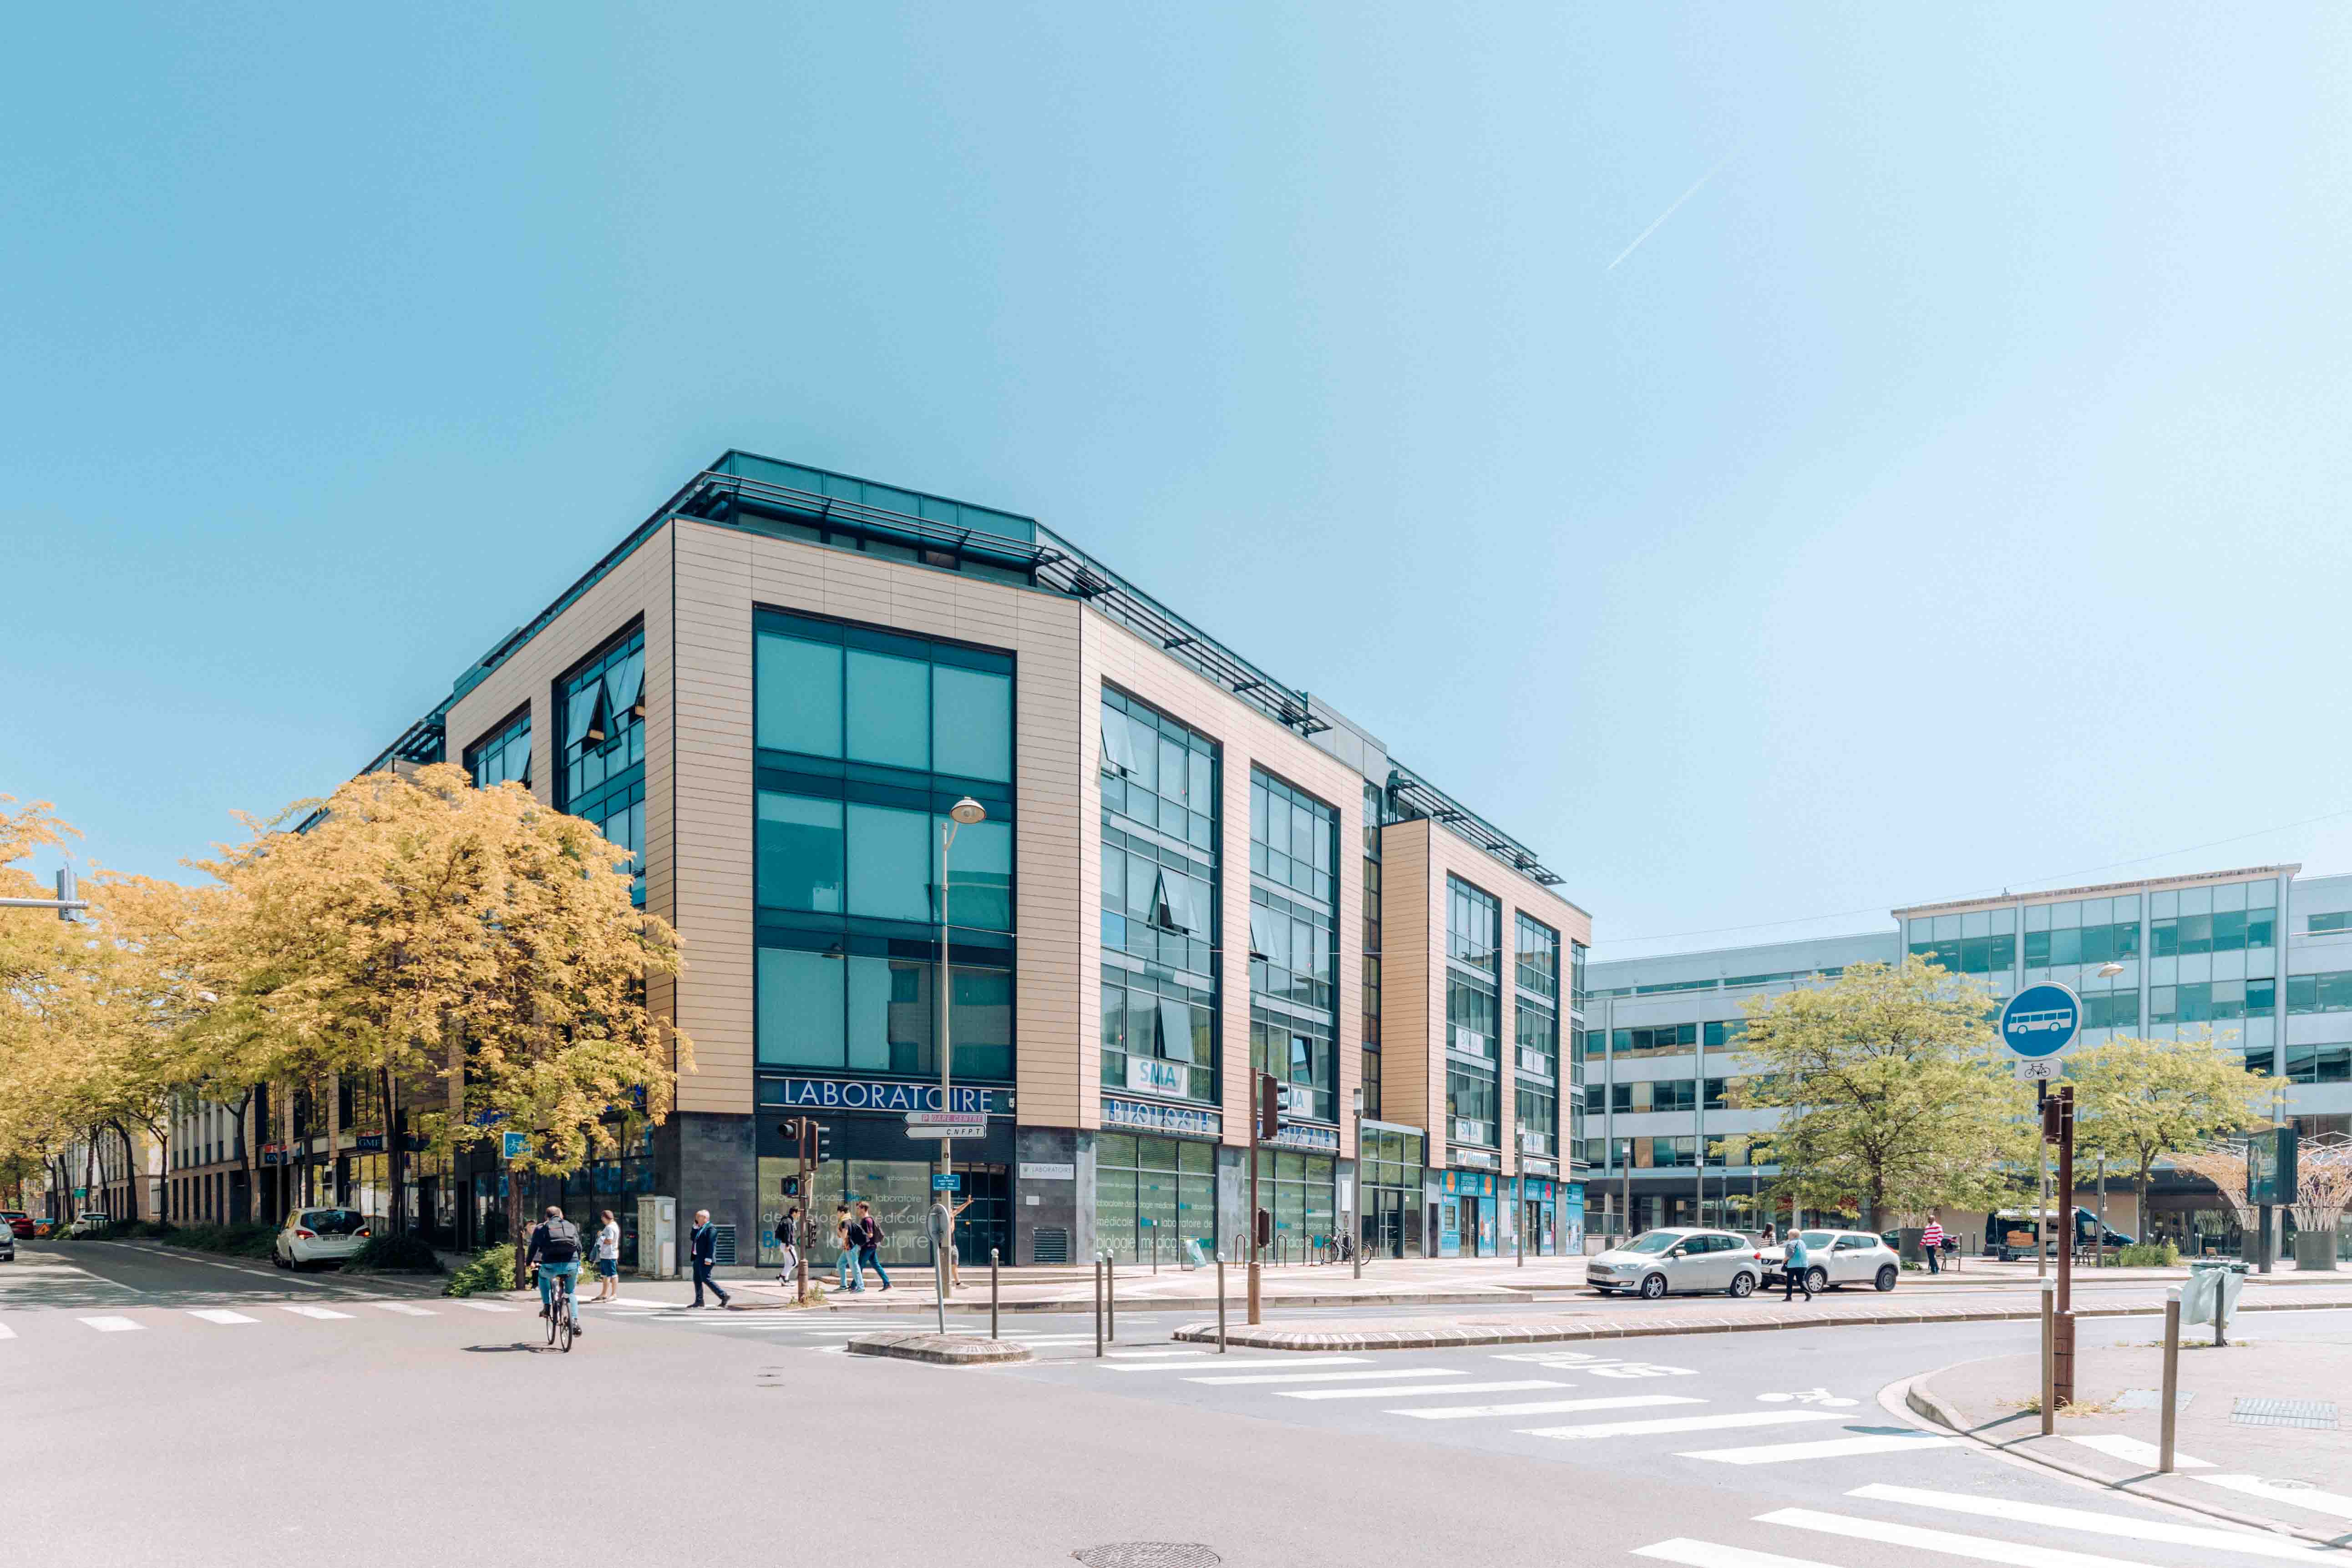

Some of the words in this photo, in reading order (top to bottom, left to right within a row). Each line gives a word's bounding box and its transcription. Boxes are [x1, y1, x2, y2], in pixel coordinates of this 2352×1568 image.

[1140, 1062, 1176, 1086] SMA
[786, 1080, 993, 1112] LABORATOIRE
[1114, 1100, 1212, 1132] BIOLOGIE
[359, 1139, 380, 1147] GMF
[876, 1194, 922, 1202] laboratoire
[1096, 1217, 1134, 1227] médicale
[1204, 1218, 1213, 1228] de
[1096, 1234, 1136, 1253] biologie
